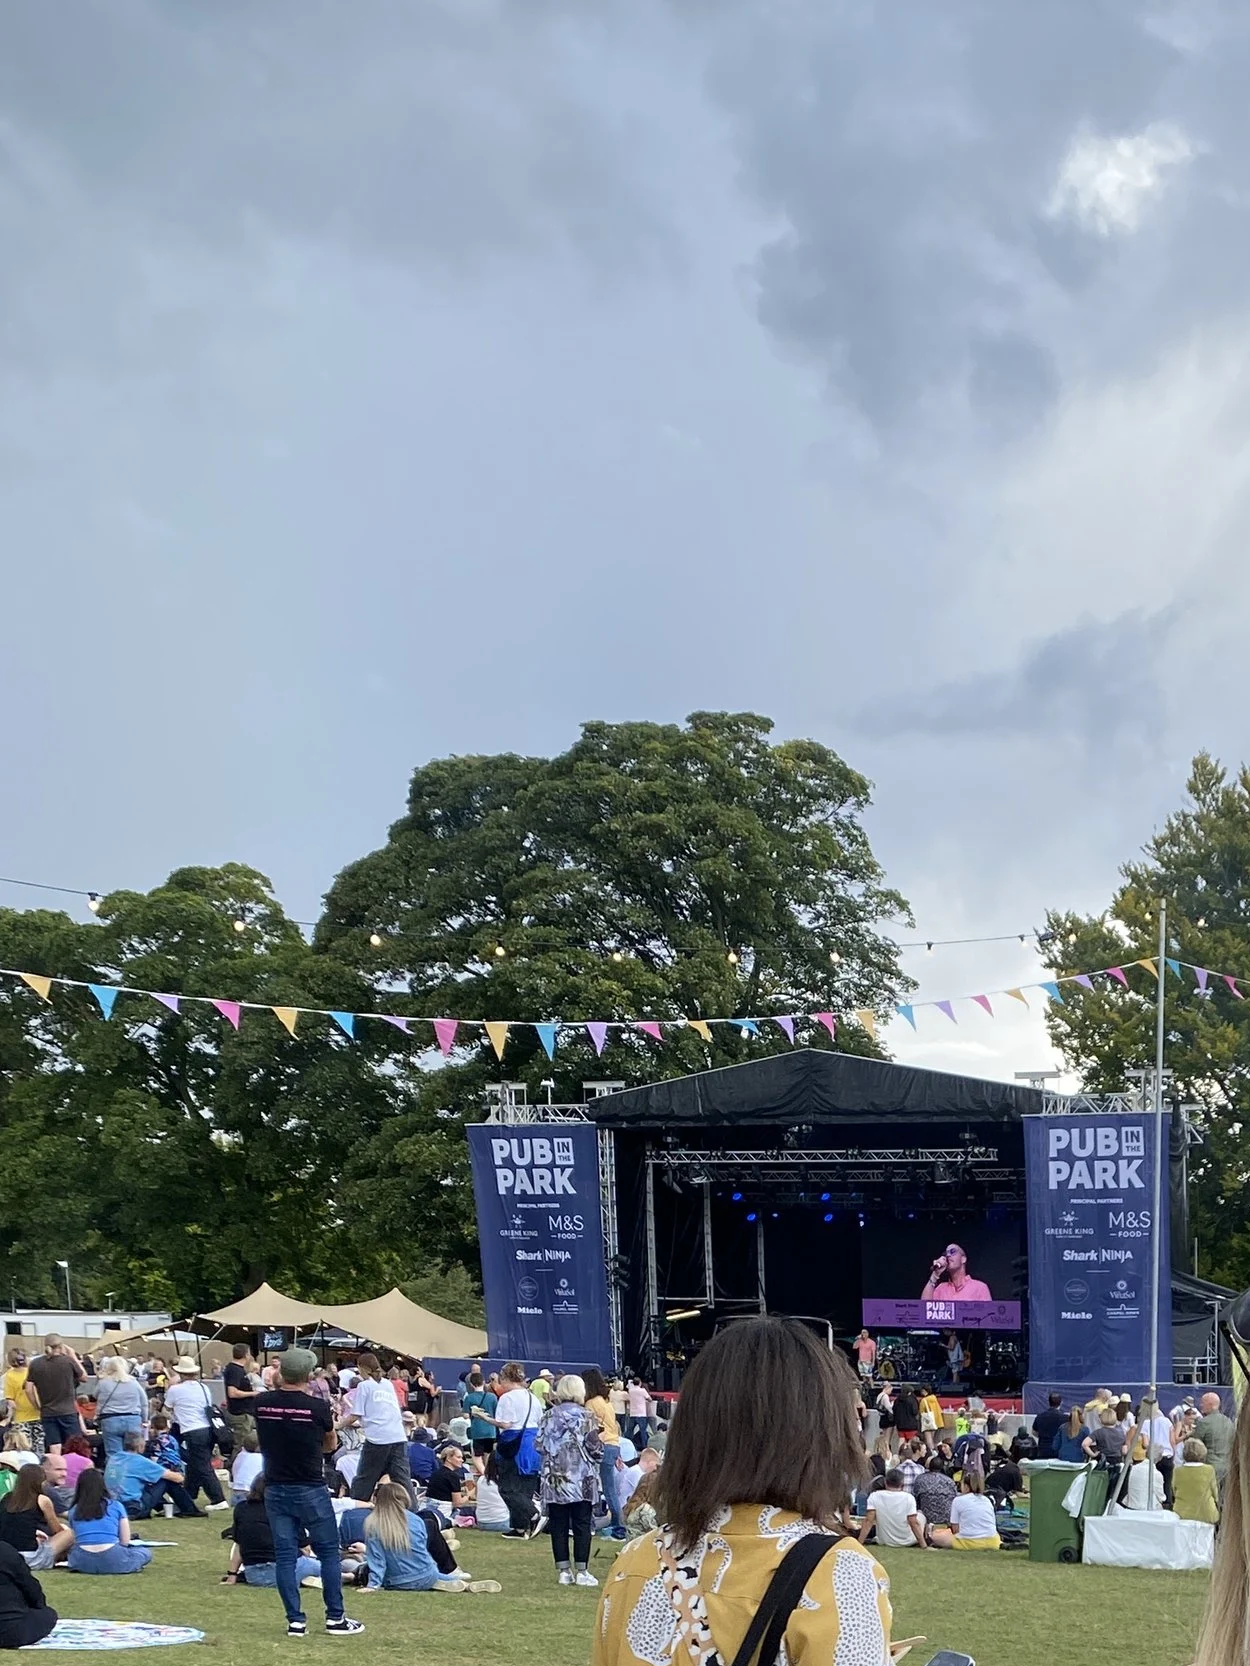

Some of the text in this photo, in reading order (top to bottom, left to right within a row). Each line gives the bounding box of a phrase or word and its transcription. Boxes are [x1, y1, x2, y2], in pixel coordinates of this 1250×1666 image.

[1048, 1127, 1119, 1158] PUB
[1125, 1130, 1140, 1143] IN
[491, 1138, 553, 1166] PUB
[557, 1141, 570, 1153] IN
[495, 1167, 577, 1195] PARK
[1048, 1159, 1146, 1190] PARK
[548, 1214, 584, 1231] M&S
[1109, 1211, 1152, 1229] M&S
[1118, 1230, 1142, 1238] FOOD
[516, 1249, 542, 1261] Shark
[1062, 1250, 1099, 1261] Shark
[926, 1301, 945, 1311] PUB
[926, 1311, 951, 1320] PARK
